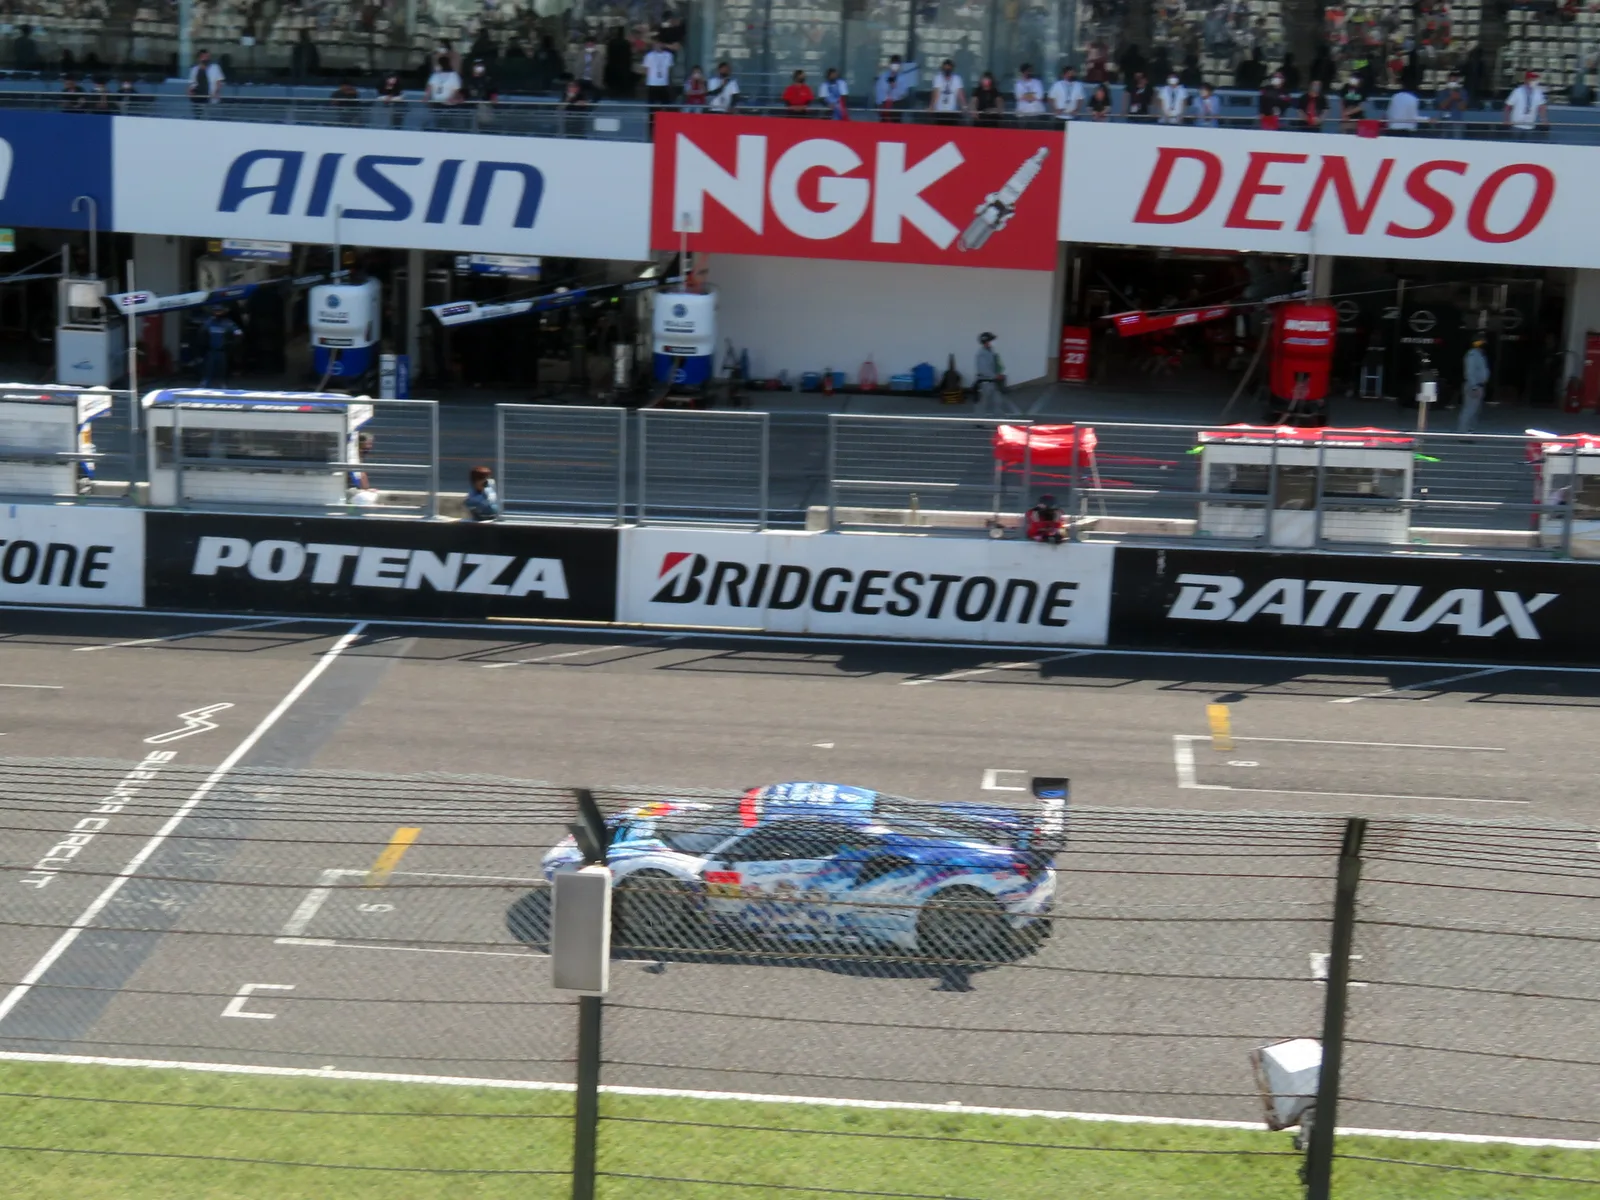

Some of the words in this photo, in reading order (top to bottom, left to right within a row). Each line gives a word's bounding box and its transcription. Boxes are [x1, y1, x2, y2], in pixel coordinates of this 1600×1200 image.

[216, 147, 545, 231] AISIN
[673, 132, 965, 251] NGK
[1132, 146, 1556, 244] DENSO
[192, 535, 568, 600] POTENZA
[647, 552, 1079, 629] BRIDGESTONE
[1167, 572, 1558, 641] BATTLAX
[20, 817, 110, 889] CIRCUIT
